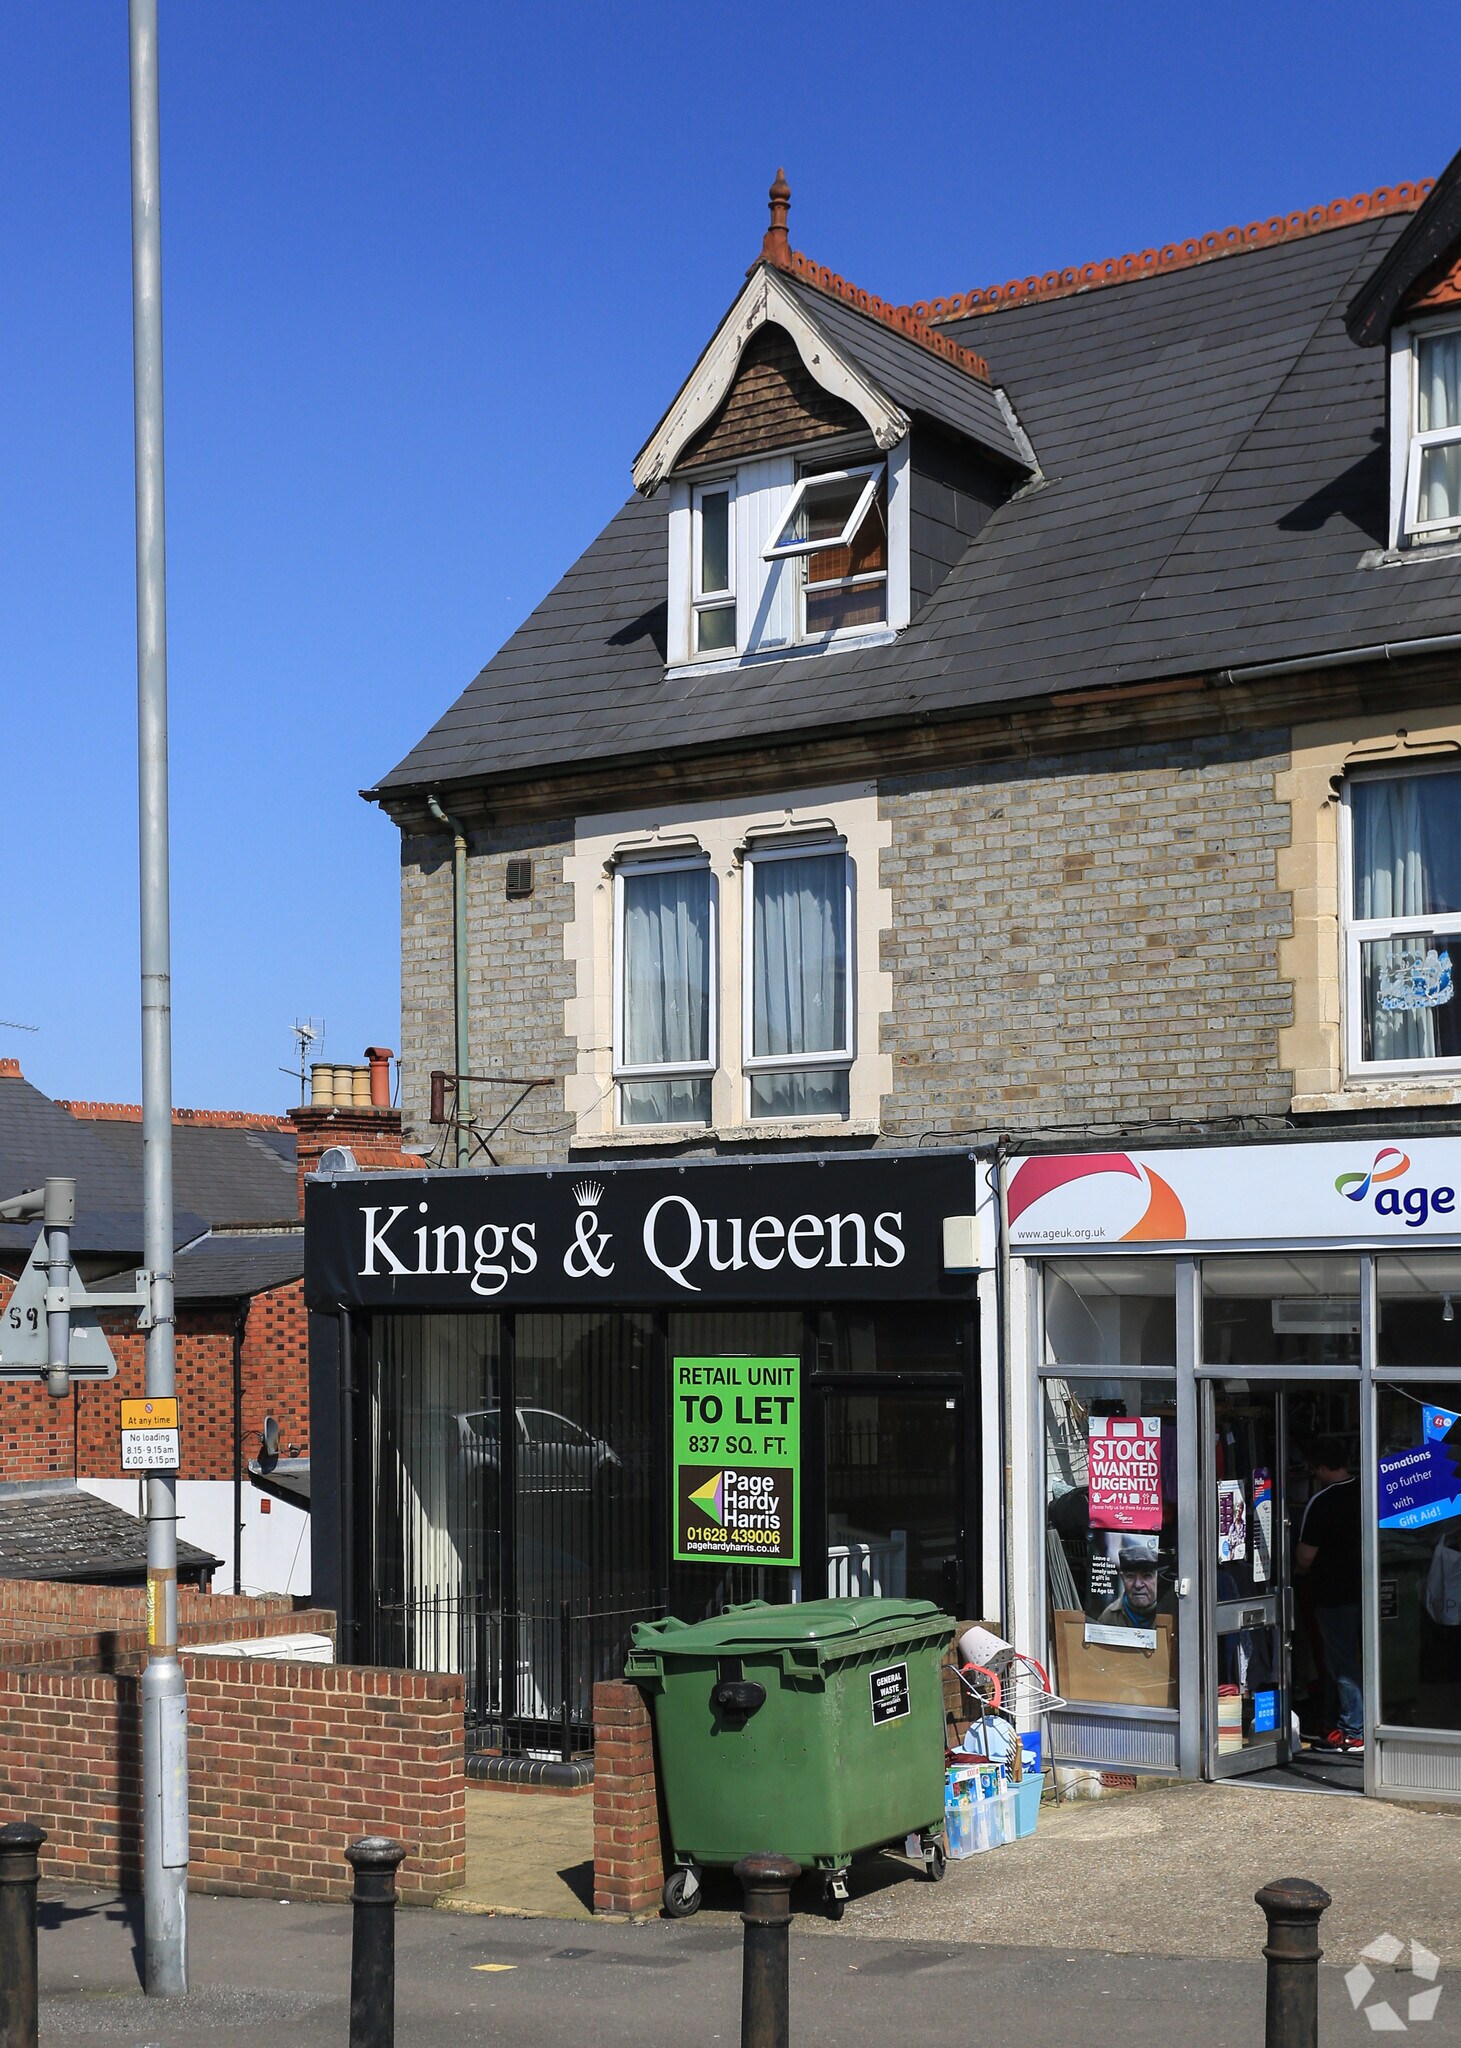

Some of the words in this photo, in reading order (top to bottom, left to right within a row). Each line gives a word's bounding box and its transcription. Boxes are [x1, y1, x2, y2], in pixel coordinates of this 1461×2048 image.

[1374, 1186, 1456, 1227] age
[1017, 1226, 1106, 1240] www.ageuk.org.uk
[357, 1202, 538, 1296] Kings
[563, 1210, 615, 1278] &
[642, 1195, 906, 1292] Queens
[679, 1367, 742, 1385] RETAIL
[748, 1367, 795, 1386] UNIT
[680, 1395, 723, 1424] TO
[735, 1396, 795, 1425] LET
[128, 1417, 137, 1425] At
[154, 1416, 171, 1424] time
[142, 1433, 170, 1442] loading
[688, 1435, 720, 1453] 837
[725, 1435, 757, 1455] SQ.
[763, 1436, 788, 1455] FT.
[1092, 1440, 1158, 1460] STOCK
[1092, 1461, 1158, 1477] WANTED
[1380, 1450, 1432, 1474] Donations
[723, 1471, 774, 1495] Page
[1091, 1477, 1159, 1492] URGENTLY
[1385, 1481, 1399, 1495] go
[1399, 1470, 1433, 1488] further
[723, 1490, 780, 1514] Hardy
[1392, 1495, 1415, 1510] with
[723, 1509, 781, 1530] Harris
[1399, 1513, 1419, 1528] Gift
[1420, 1505, 1442, 1521] Aid!
[687, 1526, 728, 1543] 01628
[730, 1527, 781, 1545] 439006
[687, 1541, 780, 1554] pagehardyharris.co.uk
[1091, 1567, 1107, 1575] lonely
[876, 1672, 902, 1687] GENERAL
[880, 1683, 900, 1697] WASTE
